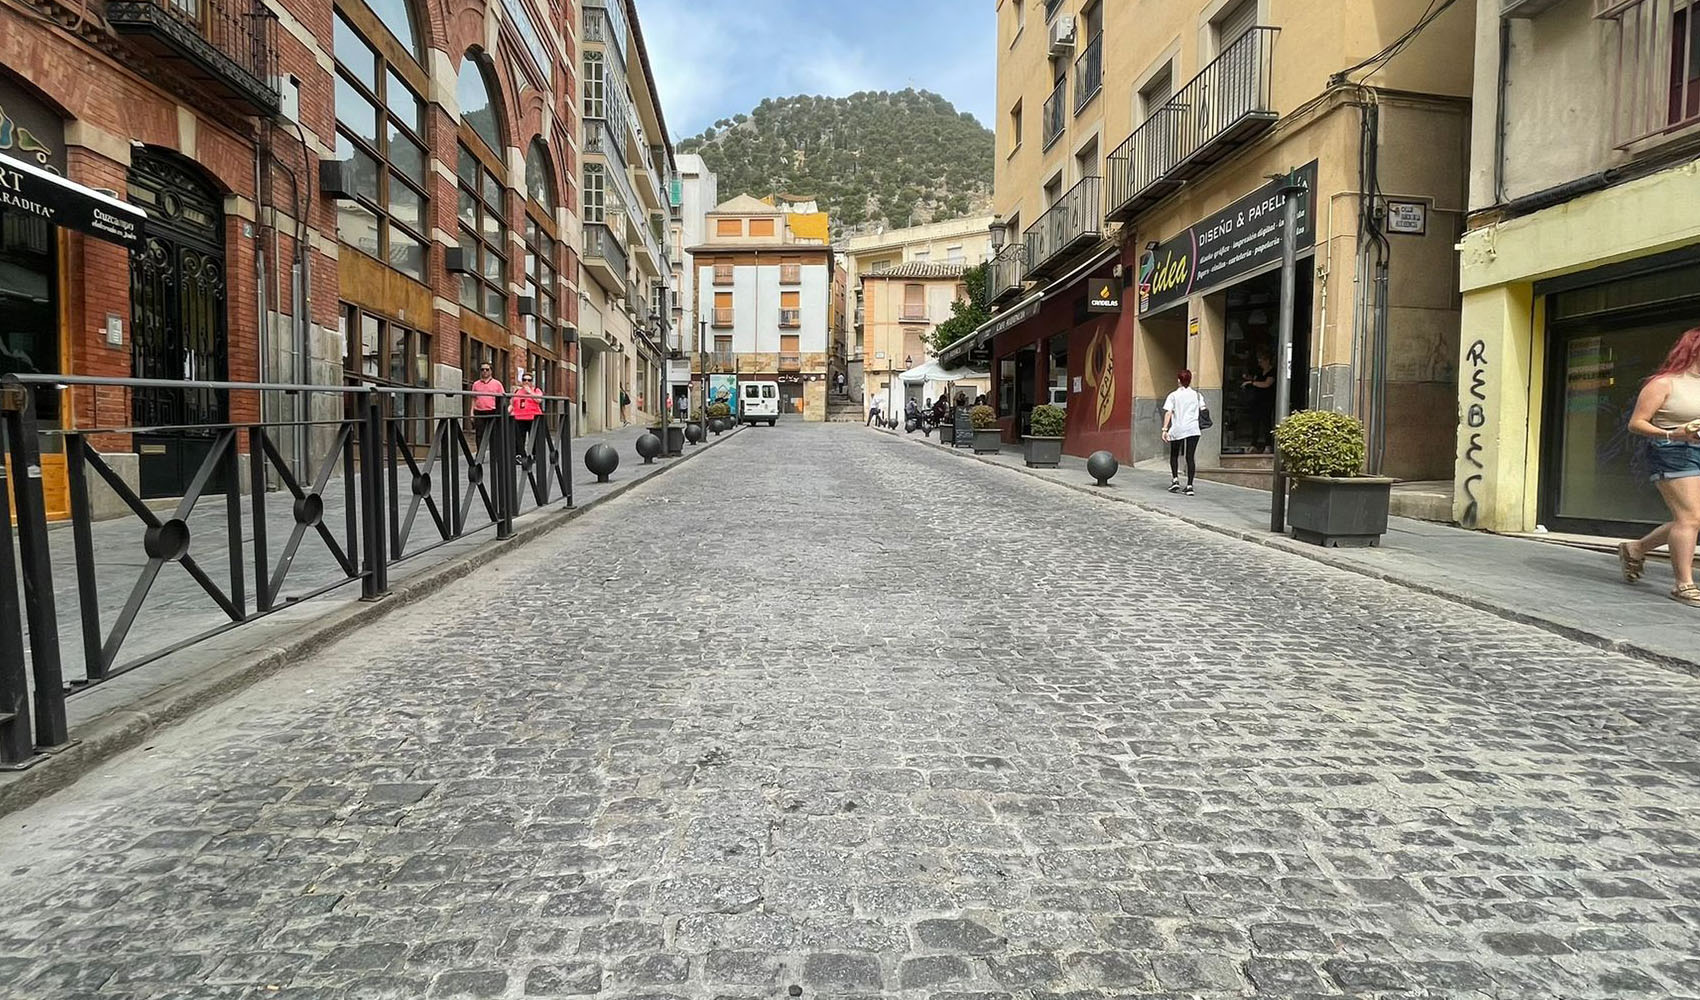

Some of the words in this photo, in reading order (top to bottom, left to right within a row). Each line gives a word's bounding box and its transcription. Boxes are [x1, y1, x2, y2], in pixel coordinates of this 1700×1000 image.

[0, 191, 55, 218] RADITA"
[1199, 218, 1233, 247] DISEÑO
[1236, 211, 1245, 228] &
[1152, 250, 1188, 295] idea
